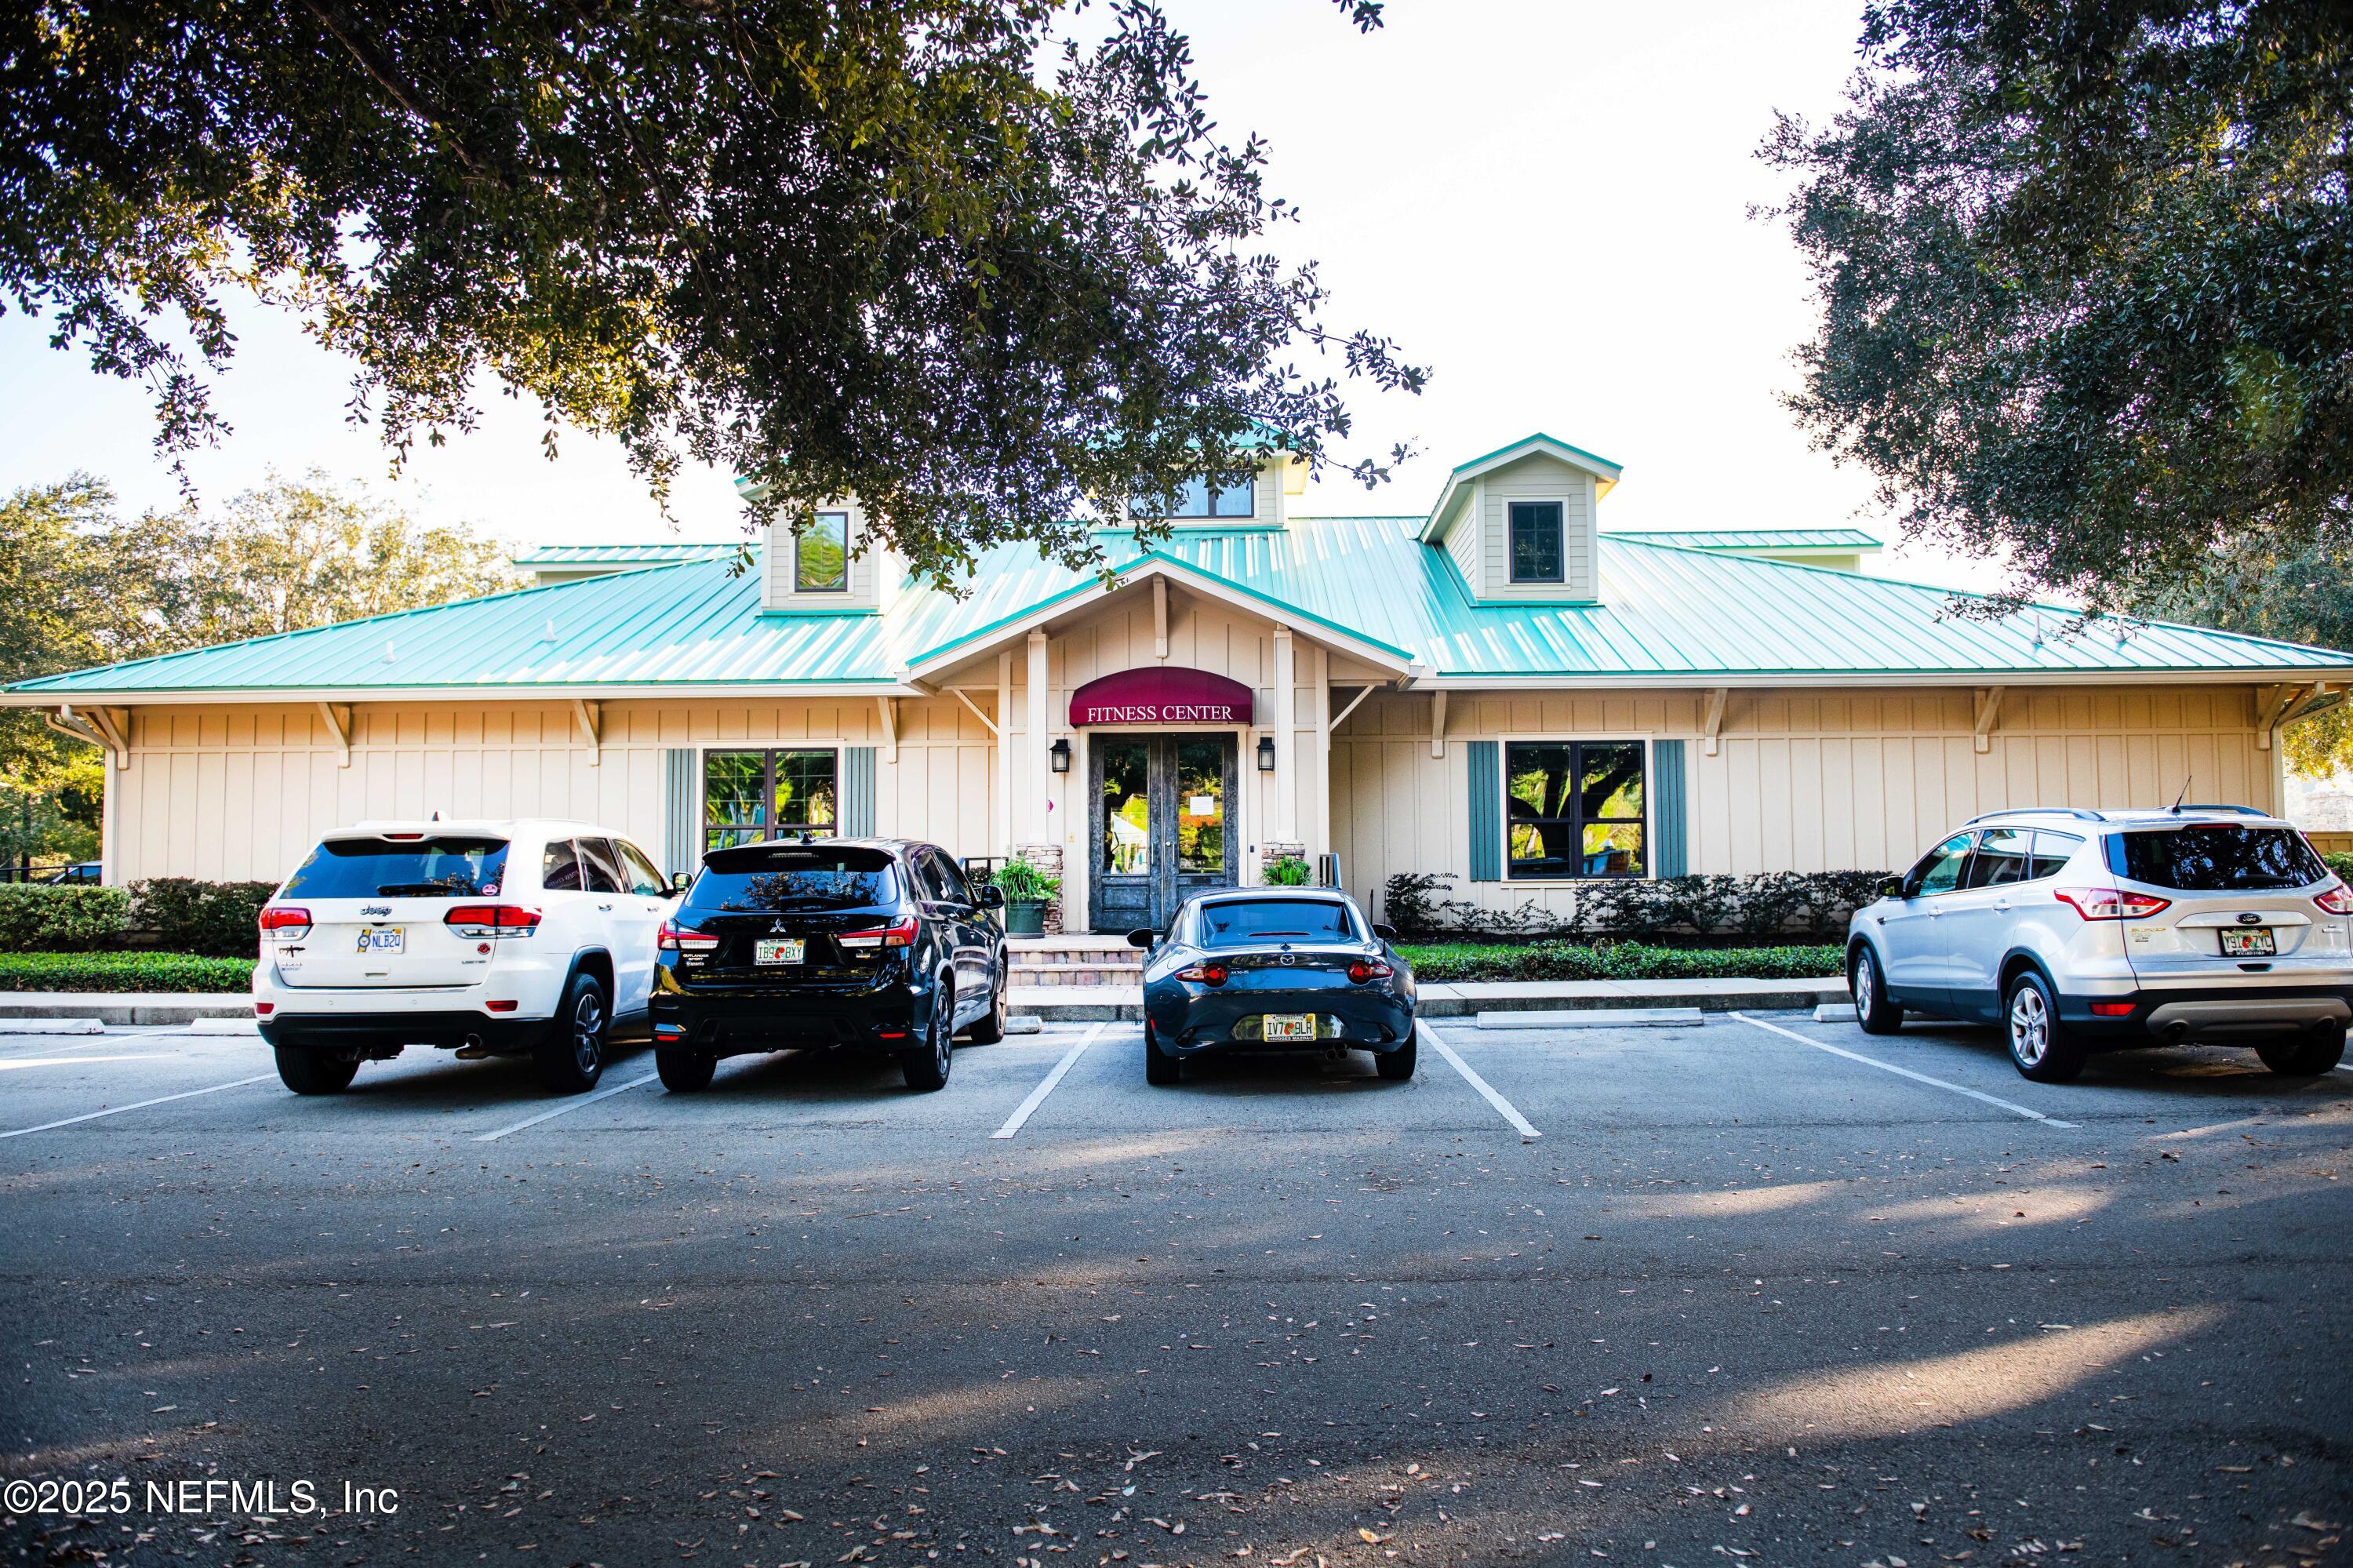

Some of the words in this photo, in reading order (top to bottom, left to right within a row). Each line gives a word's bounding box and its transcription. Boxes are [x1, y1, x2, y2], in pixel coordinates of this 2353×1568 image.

[1087, 706, 1157, 722] FITNESS
[1162, 705, 1233, 720] CENTER
[360, 905, 392, 916] Jeep
[1267, 1022, 1284, 1035] IV7
[1295, 1022, 1312, 1035] 9LR
